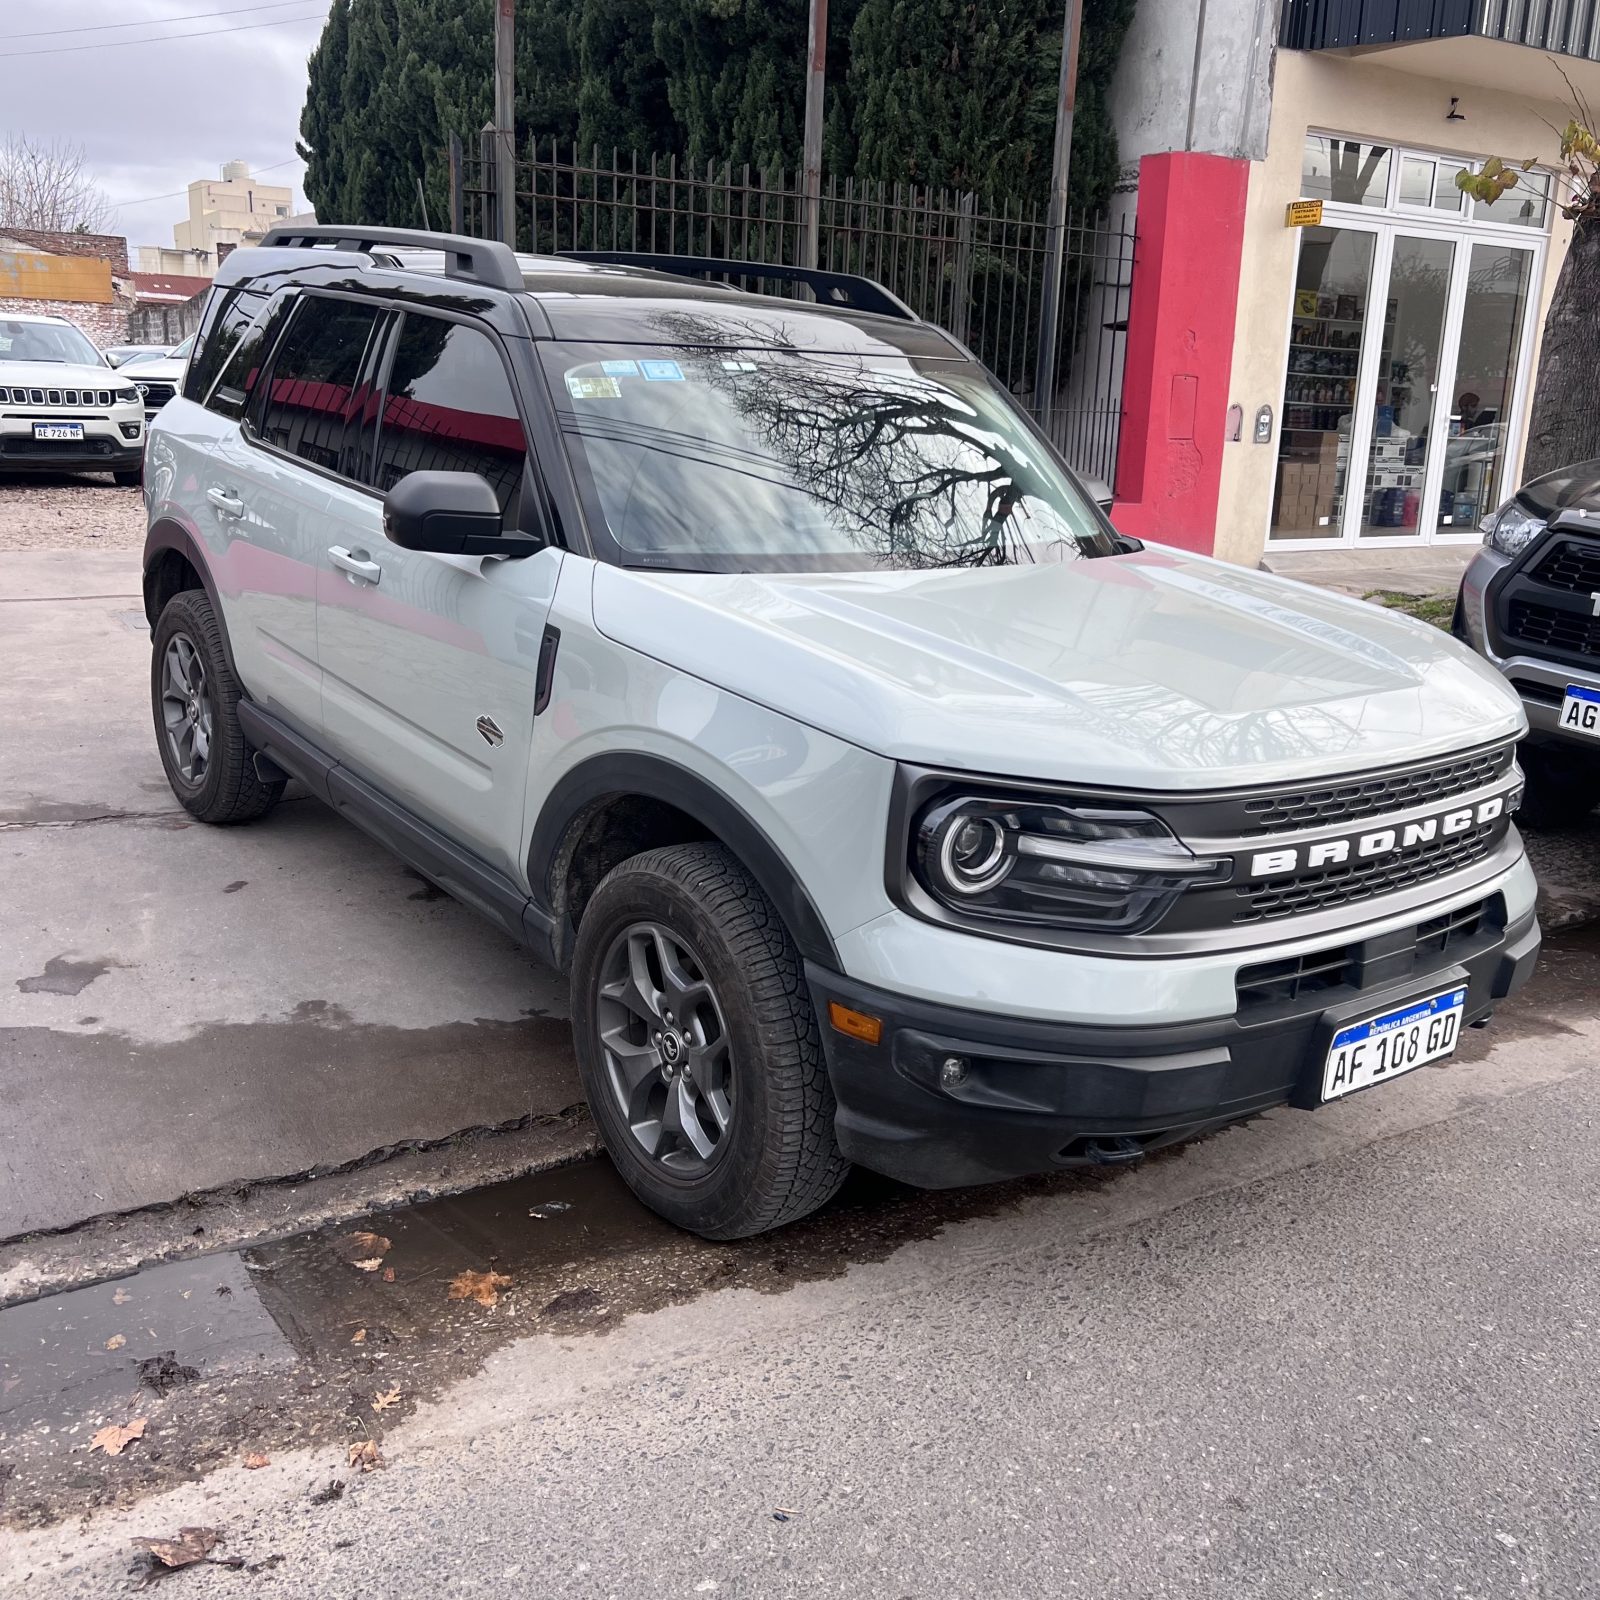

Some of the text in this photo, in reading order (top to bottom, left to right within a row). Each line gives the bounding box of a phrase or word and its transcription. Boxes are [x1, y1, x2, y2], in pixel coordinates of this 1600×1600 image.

[38, 429, 81, 438] AE 726 NF
[1566, 701, 1599, 729] AG
[1251, 798, 1503, 876] BRONCO
[1401, 1008, 1432, 1026] ARGENTINA
[1332, 1012, 1456, 1091] AF 108 GD
